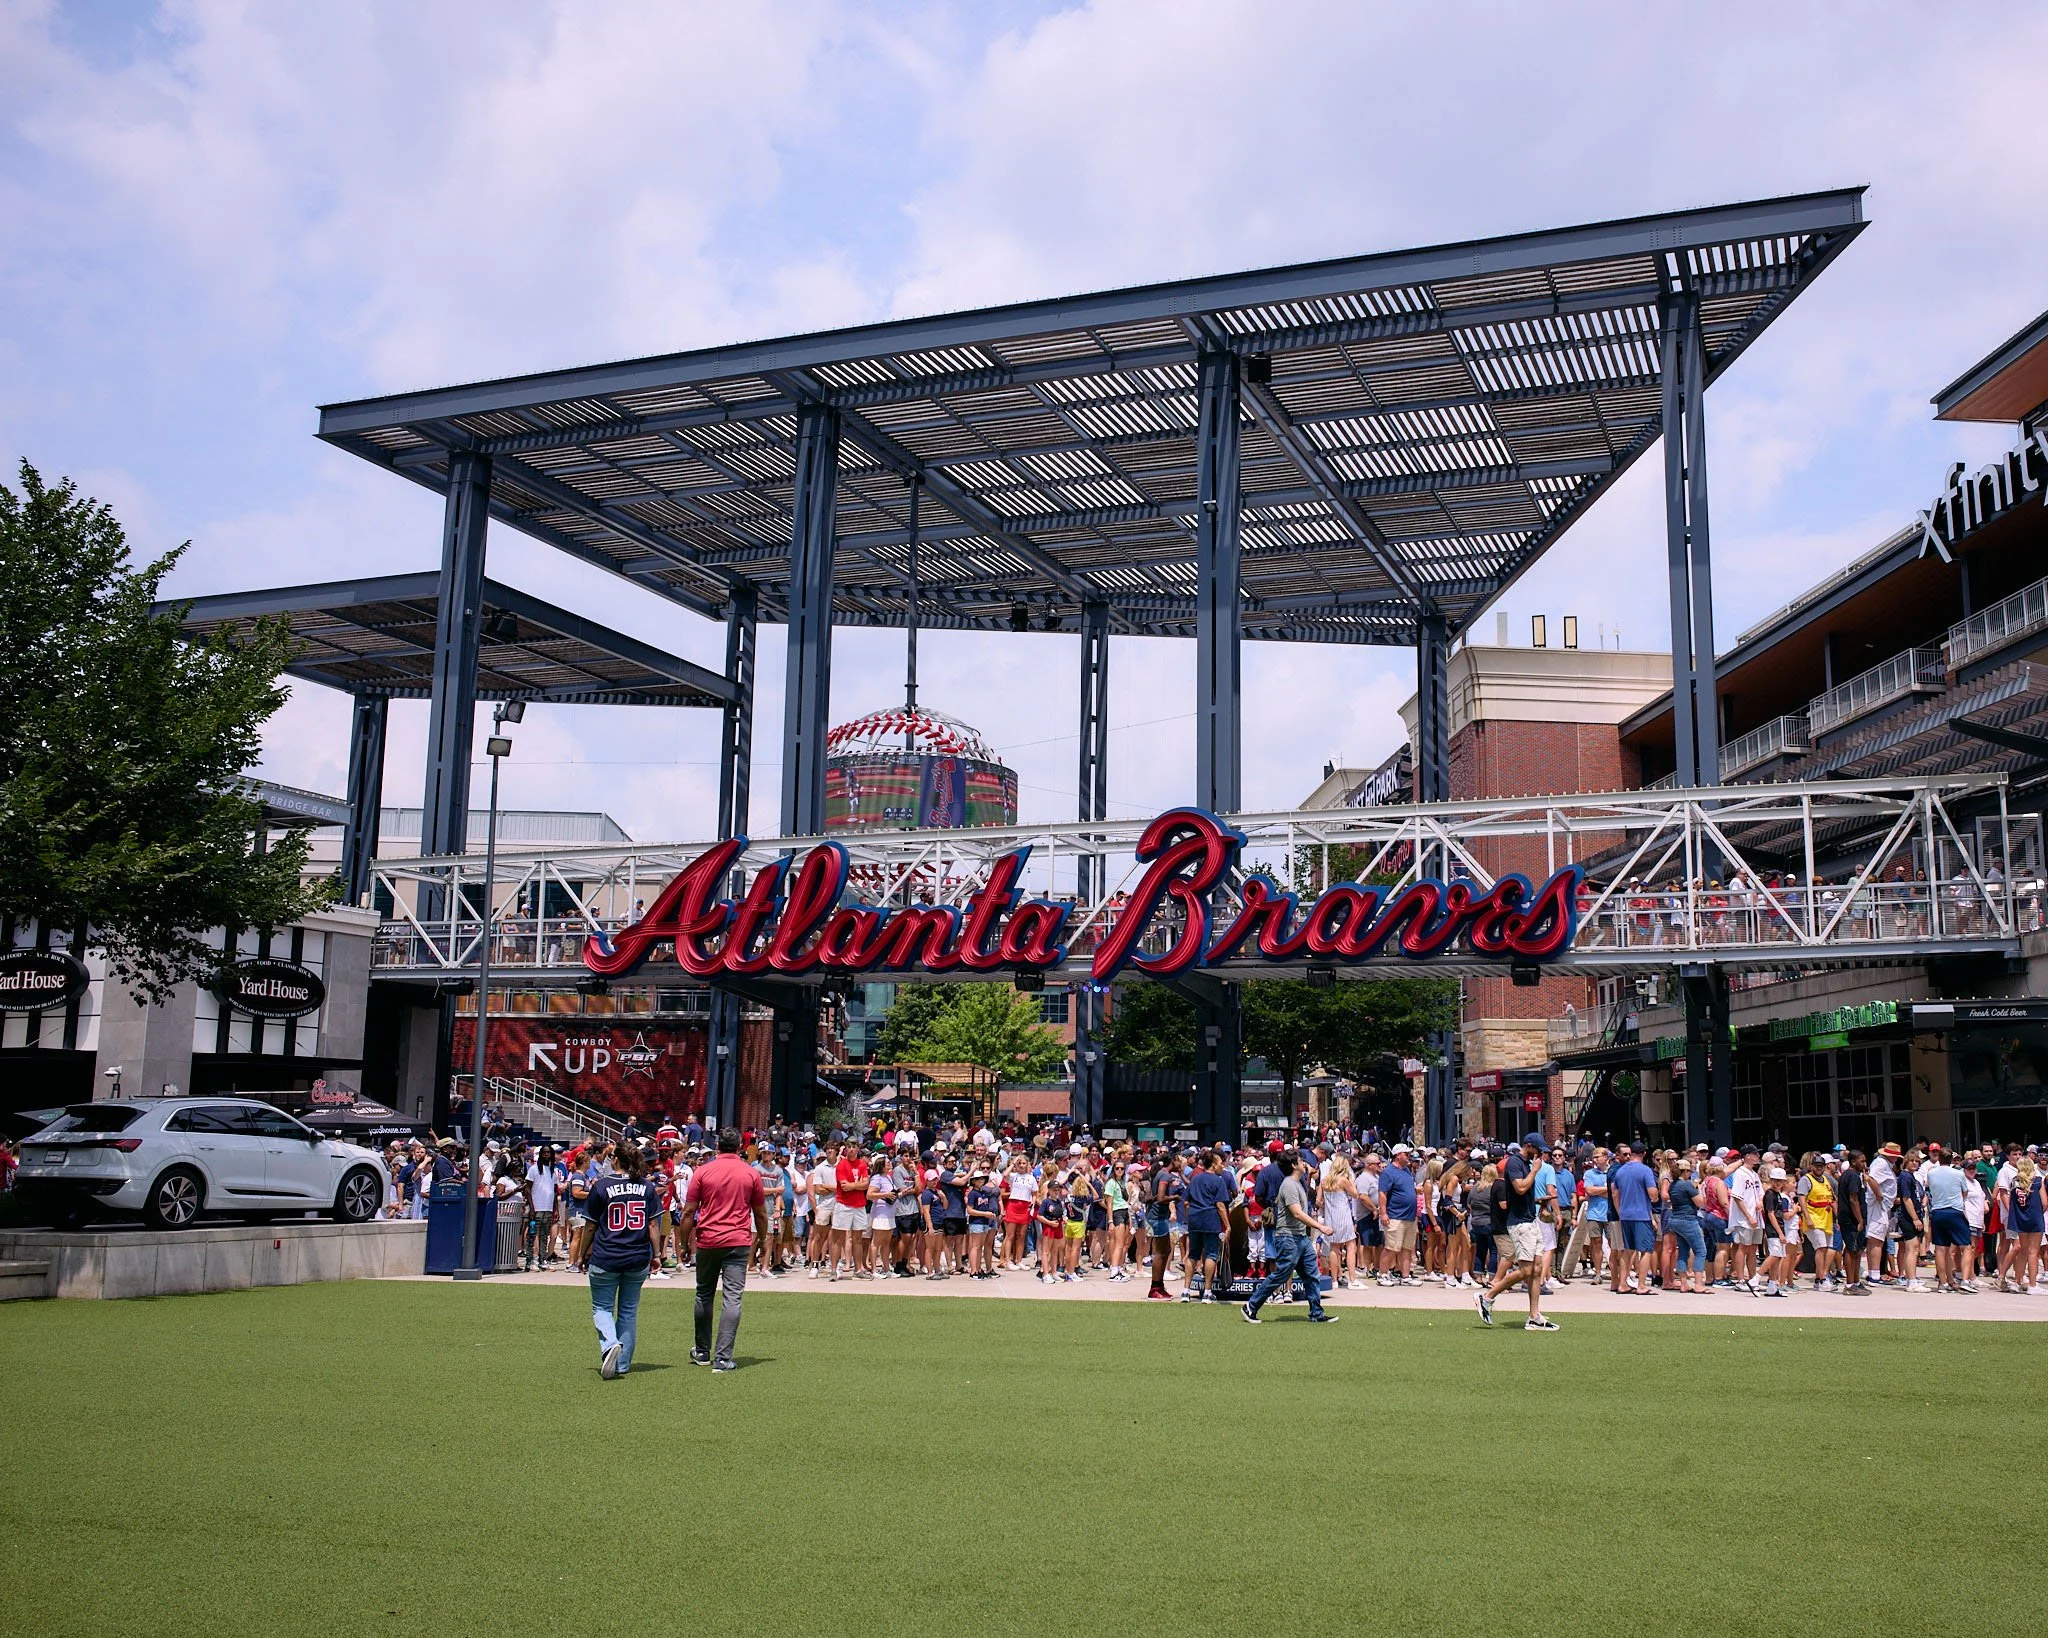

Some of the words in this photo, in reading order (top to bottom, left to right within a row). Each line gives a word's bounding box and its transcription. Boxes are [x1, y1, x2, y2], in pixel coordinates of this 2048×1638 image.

[1375, 762, 1399, 804] PARK
[270, 795, 308, 812] BRIDGE
[311, 804, 332, 817] BAR
[583, 834, 1076, 981] Atlanta
[1091, 806, 1585, 984] Braves
[22, 970, 66, 989] House
[239, 977, 268, 996] Yard
[269, 979, 309, 1001] House
[1810, 1008, 1840, 1036] FRESH
[1839, 1004, 1868, 1032] BREW
[1869, 1000, 1897, 1027] BAR
[1969, 1008, 1990, 1017] Fresh
[1990, 1008, 2009, 1017] Cold
[2009, 1007, 2028, 1016] Beer
[565, 1038, 612, 1046] COWBOY
[564, 1048, 611, 1074] UP
[619, 1052, 658, 1062] PBR
[368, 1125, 412, 1136] yardhouse.com
[606, 1182, 647, 1199] NELSON
[607, 1200, 646, 1232] 05
